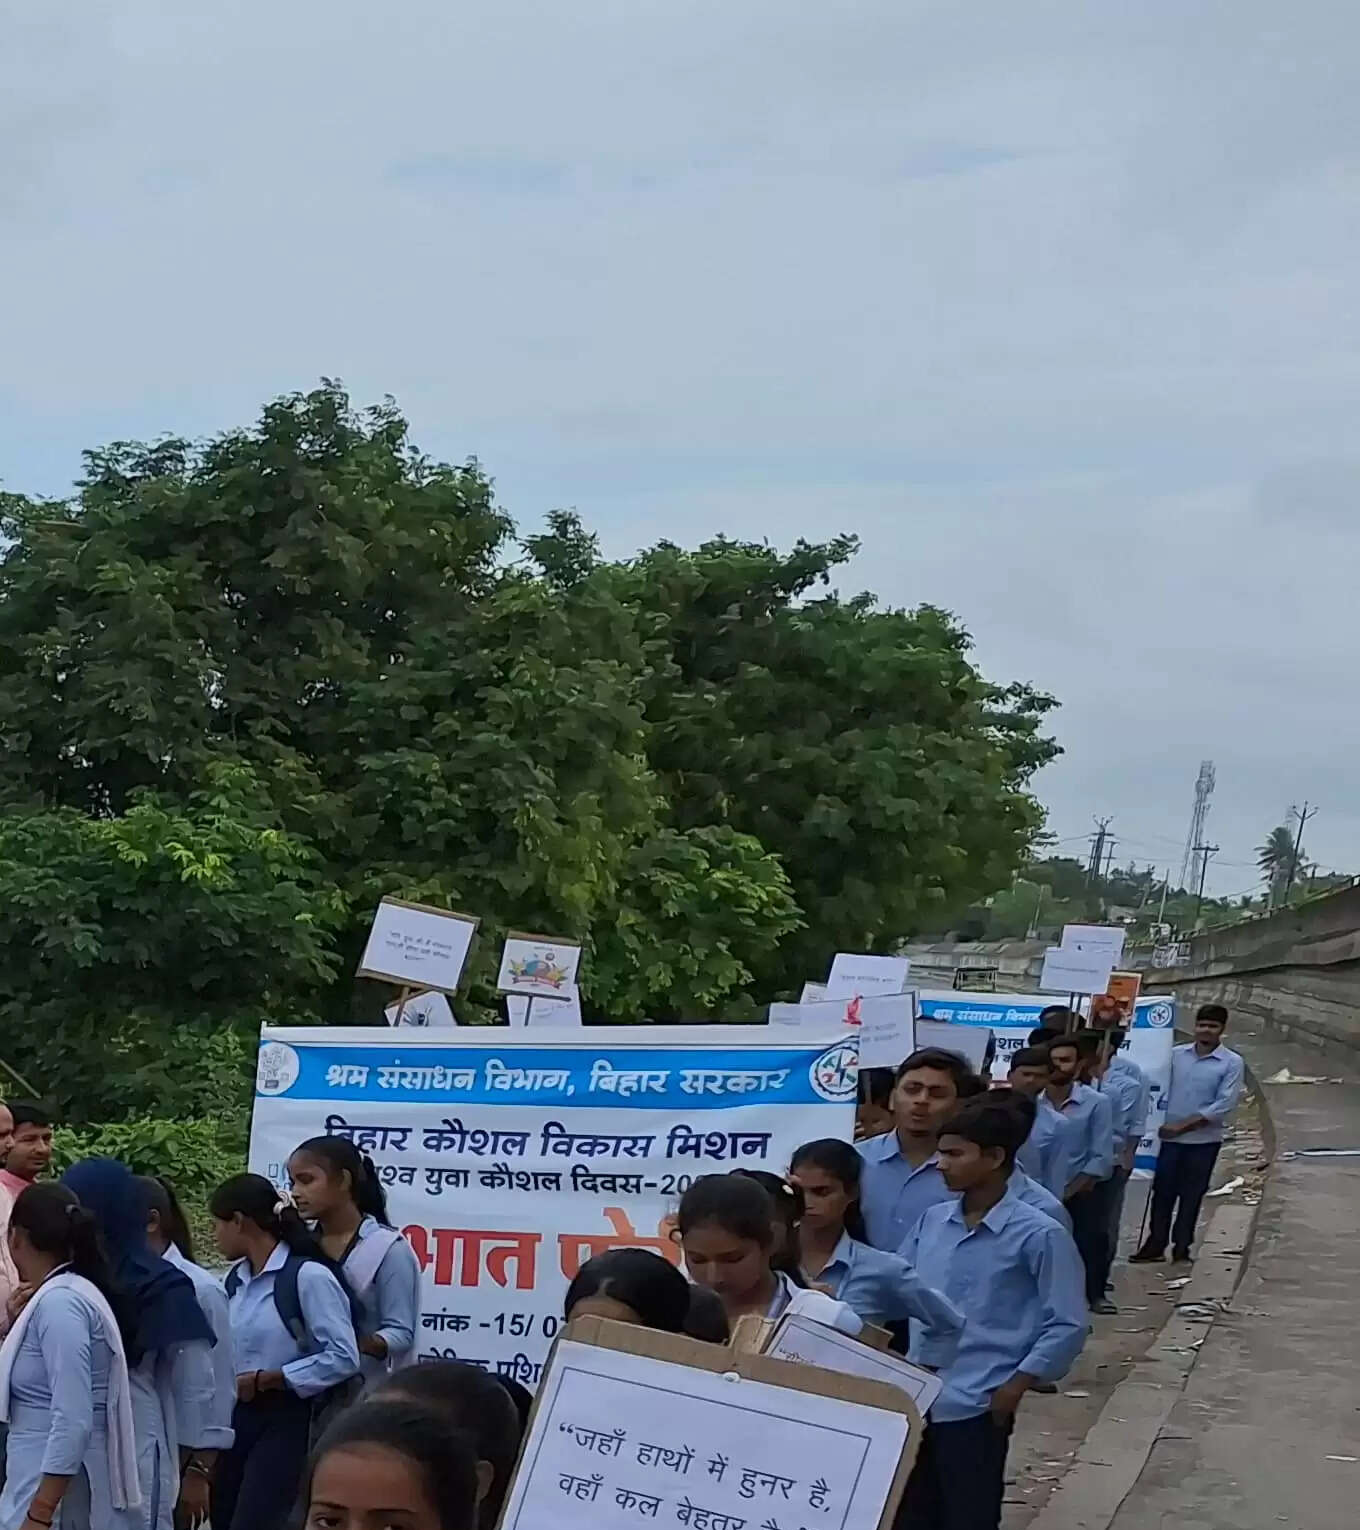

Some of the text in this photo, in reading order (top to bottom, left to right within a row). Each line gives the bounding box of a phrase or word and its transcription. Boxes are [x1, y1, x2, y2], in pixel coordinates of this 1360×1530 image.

[325, 1058, 790, 1097] श्रम संसाधन विभाग, बिहार सरकार
[422, 1118, 531, 1157] कौशल
[541, 1120, 656, 1158] विकास
[666, 1124, 772, 1160] मिशन
[424, 1167, 470, 1196] युवा
[478, 1162, 563, 1192] कौशल
[558, 1422, 626, 1458] “जहाँ
[636, 1440, 696, 1475] हाथों
[708, 1453, 730, 1483] में
[739, 1466, 797, 1500] हुनर
[557, 1472, 605, 1503] वहाँ
[615, 1485, 664, 1520] कल
